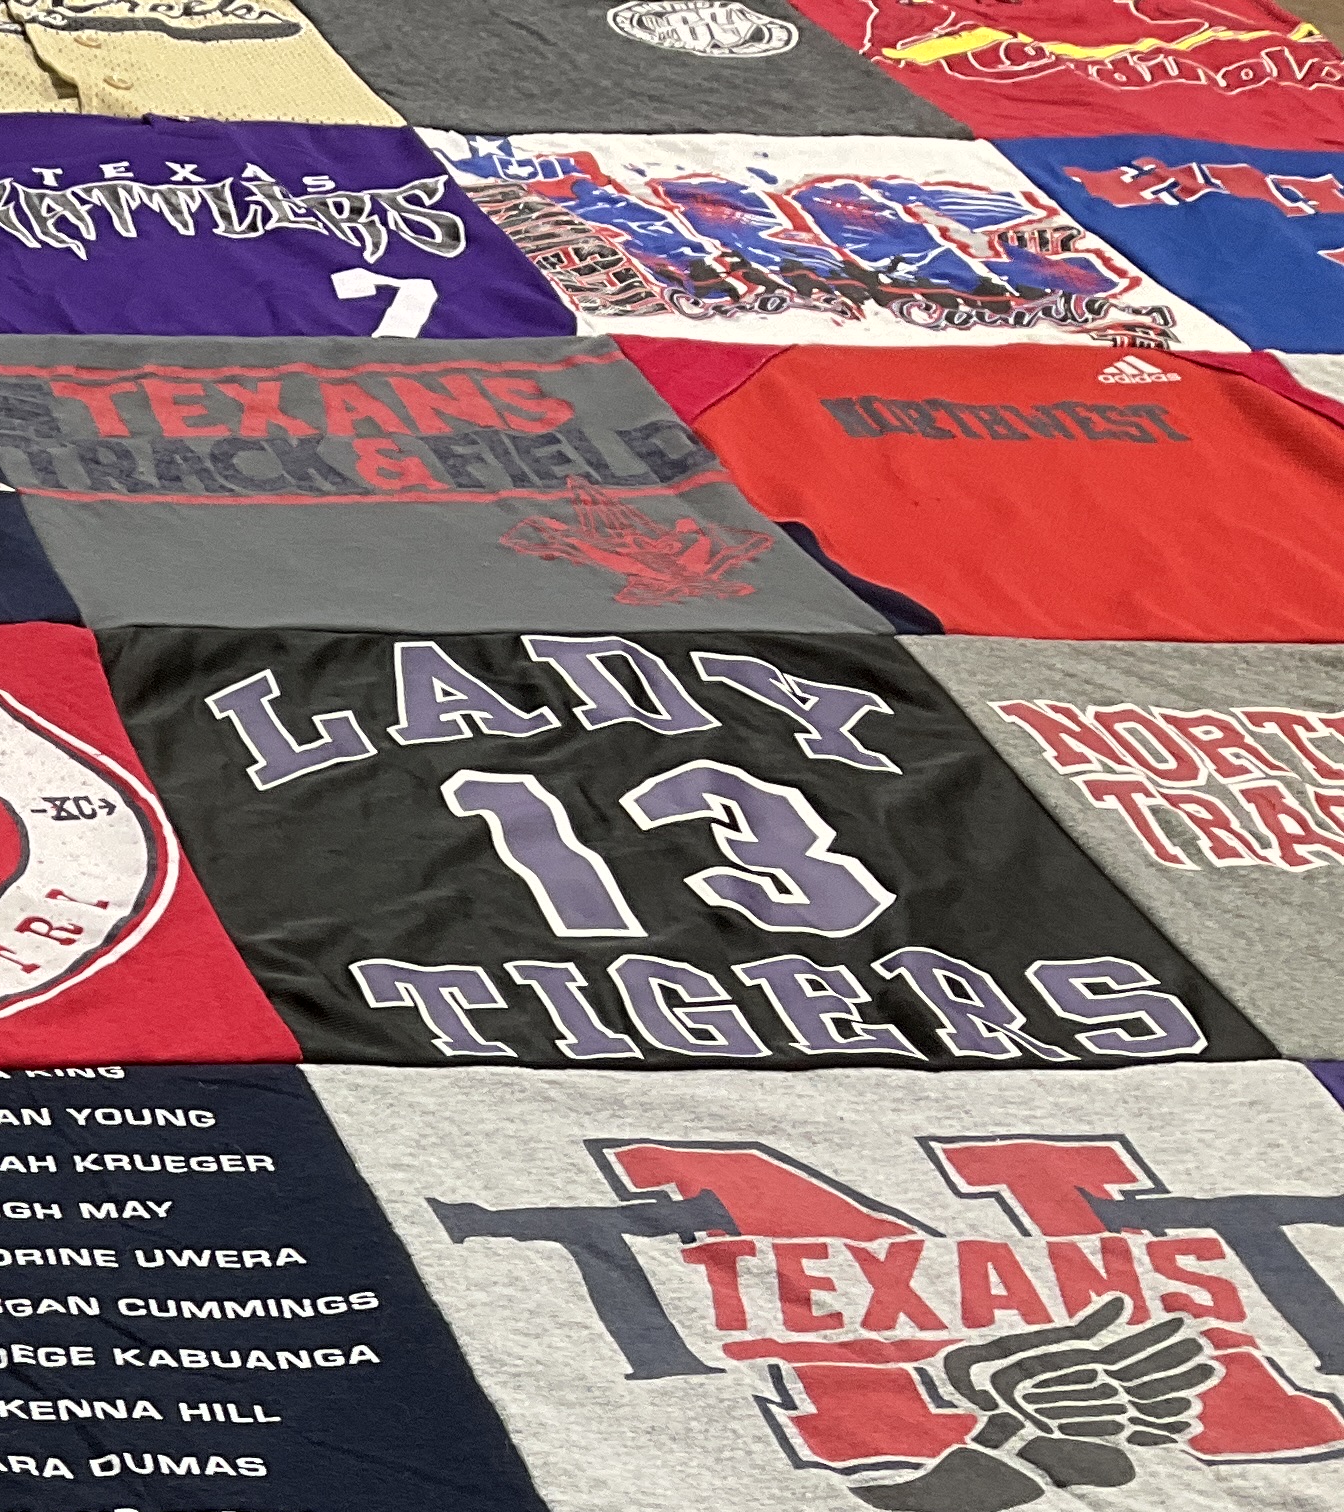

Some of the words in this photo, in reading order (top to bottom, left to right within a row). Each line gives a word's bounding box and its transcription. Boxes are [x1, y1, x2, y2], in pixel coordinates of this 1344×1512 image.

[31, 160, 336, 194] TEXAS
[330, 266, 438, 338] 7
[1097, 367, 1181, 385] adidas
[48, 373, 575, 438] TEXANS
[819, 395, 1193, 444] NORTHWEST
[203, 634, 904, 792] LADY
[987, 699, 1344, 788] NORT
[439, 758, 898, 939] 13
[348, 945, 1209, 1063] TIGERS
[65, 1108, 216, 1128] YOUNG
[72, 1153, 276, 1174] KRUEGER
[78, 1200, 173, 1220] MAY
[134, 1247, 307, 1269] UWERA
[679, 1234, 1248, 1334] TEXANS
[117, 1291, 380, 1319] CUMMINGS
[112, 1344, 381, 1371] KABUANGA
[178, 1402, 282, 1424] HILL
[88, 1452, 268, 1477] DUMAS
